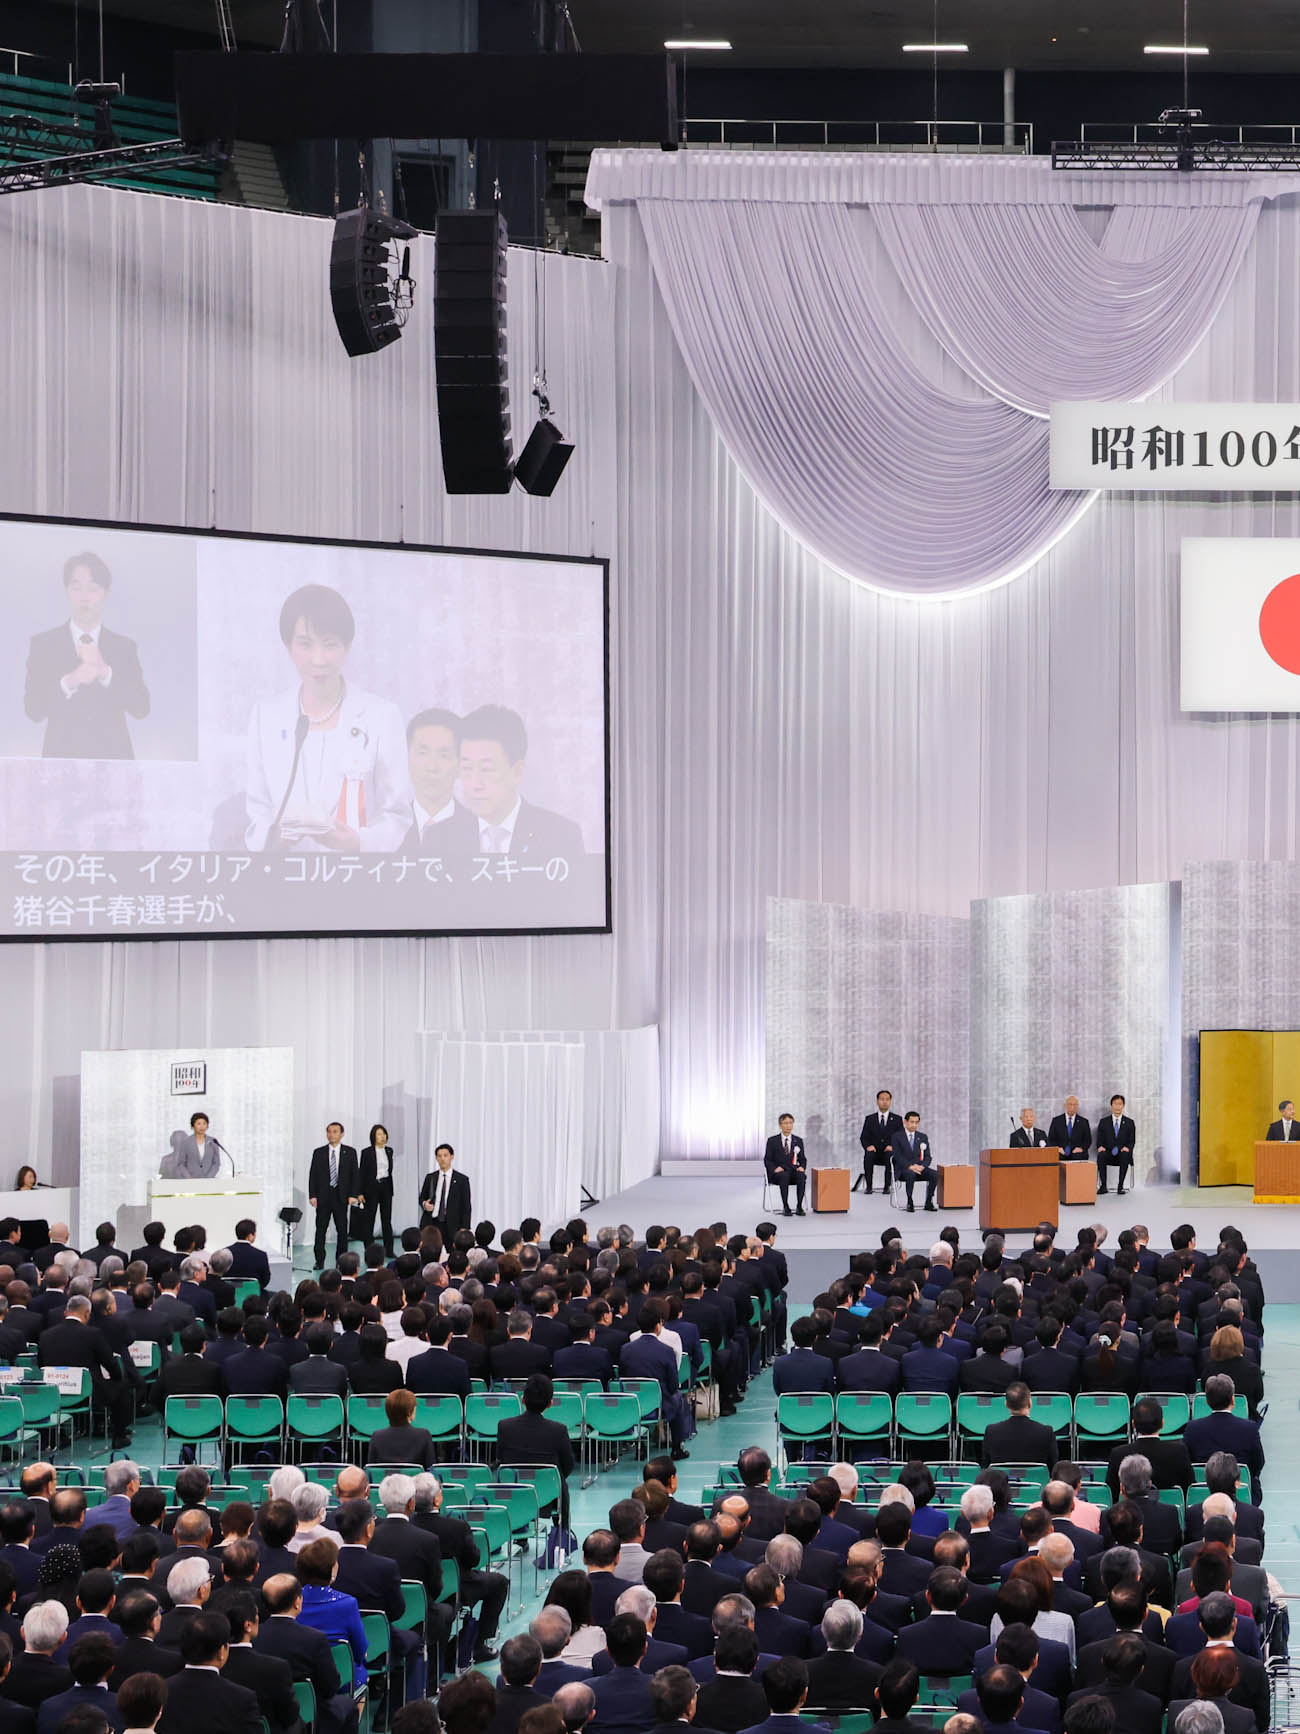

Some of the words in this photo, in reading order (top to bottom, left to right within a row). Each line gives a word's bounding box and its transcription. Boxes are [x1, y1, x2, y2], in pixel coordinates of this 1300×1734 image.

[13, 895, 236, 927] 猪谷千春選手が、
